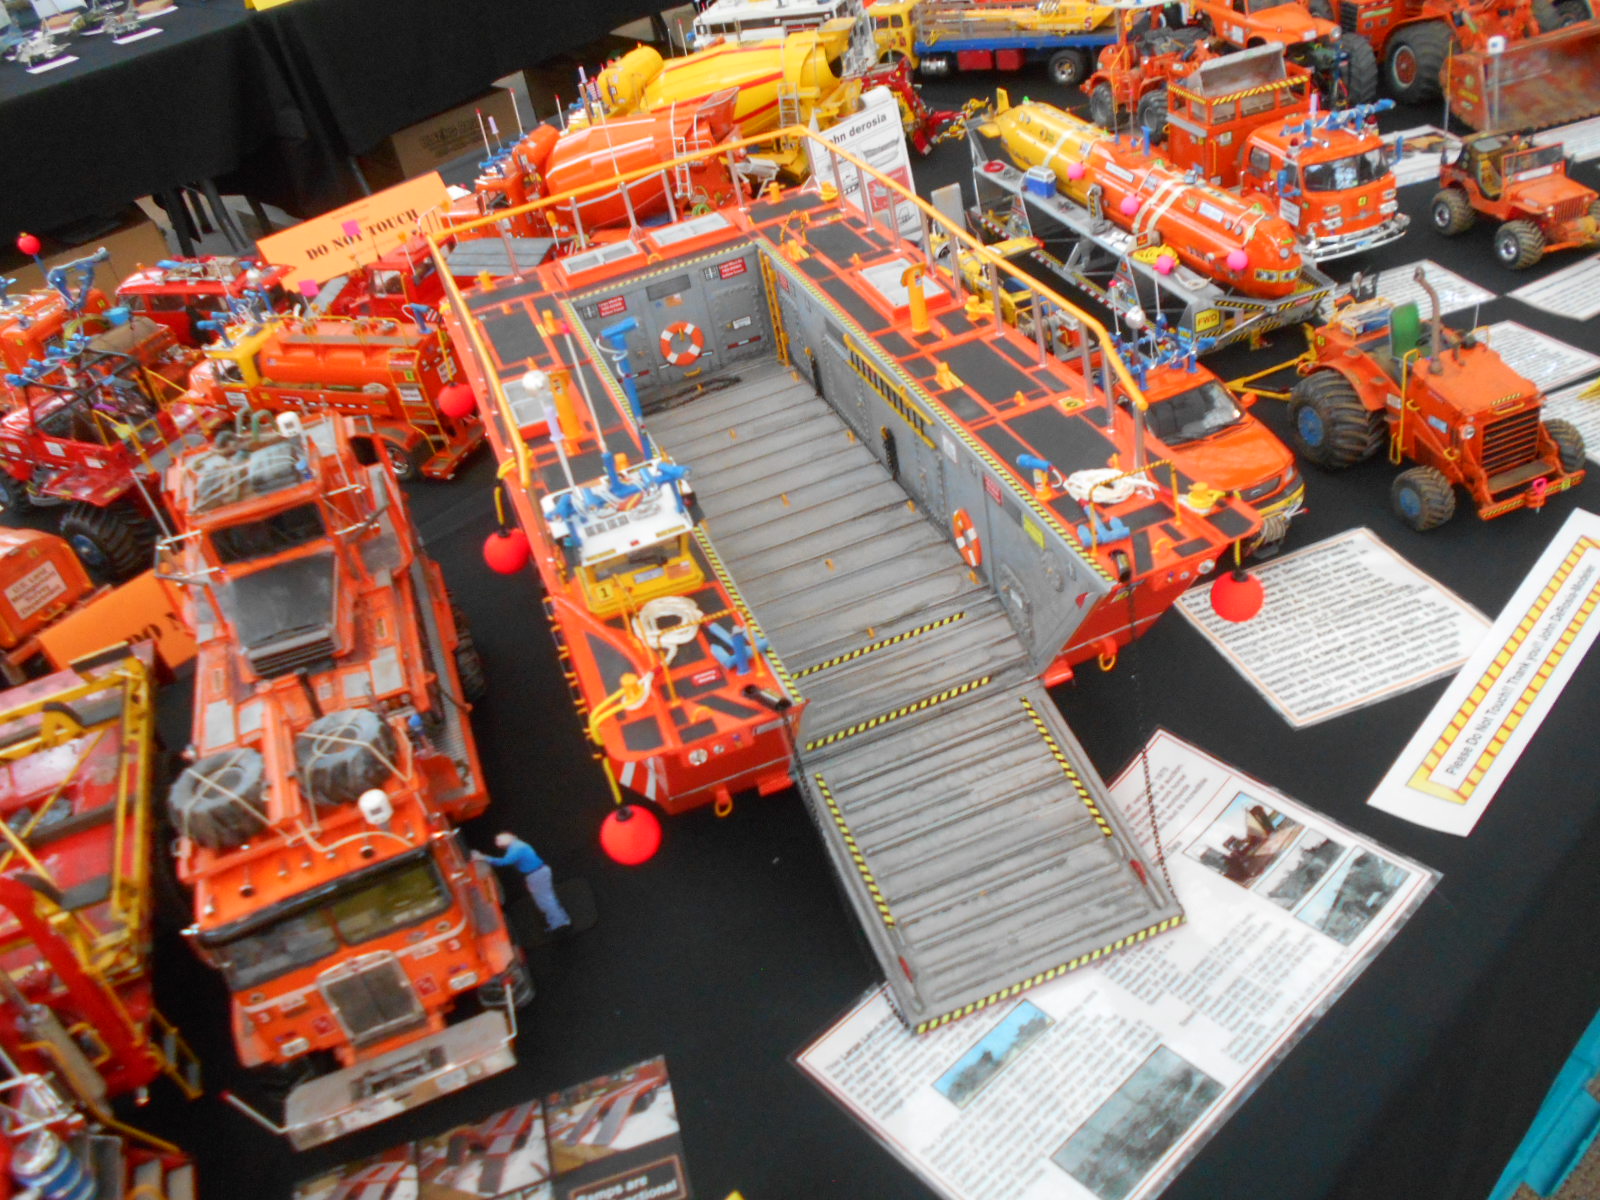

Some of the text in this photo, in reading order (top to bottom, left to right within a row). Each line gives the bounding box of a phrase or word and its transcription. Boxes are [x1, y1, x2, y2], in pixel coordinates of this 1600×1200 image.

[849, 113, 888, 138] derosia
[306, 243, 329, 260] DO
[366, 208, 420, 237] TOUCH
[601, 587, 610, 598] 1
[1446, 747, 1472, 776] Please
[1466, 733, 1482, 746] Do
[1475, 716, 1494, 732] Not
[1506, 663, 1530, 685] Thank
[1539, 622, 1557, 641] John
[626, 1175, 649, 1191] are
